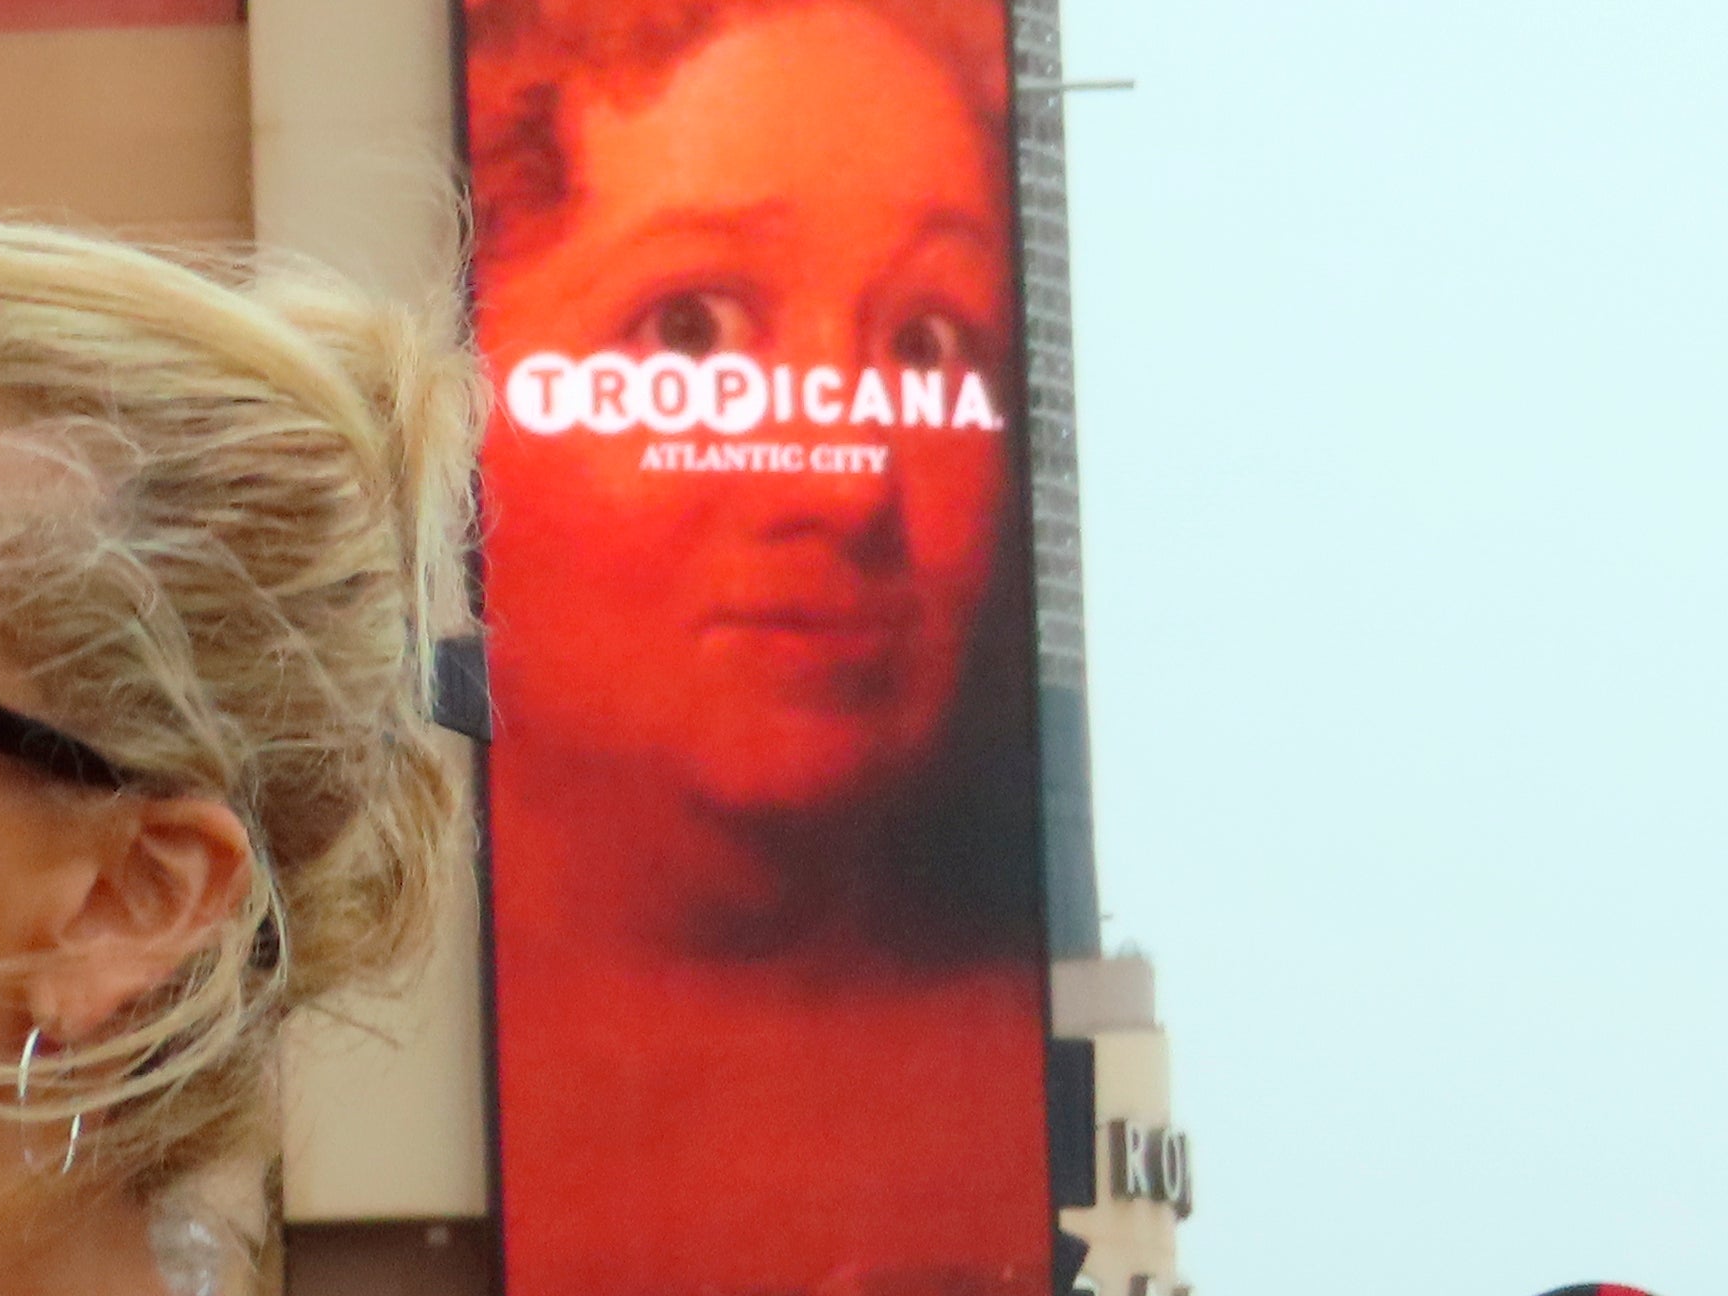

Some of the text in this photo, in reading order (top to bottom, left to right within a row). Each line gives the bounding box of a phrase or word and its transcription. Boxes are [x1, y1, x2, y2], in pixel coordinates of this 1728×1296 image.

[507, 351, 1002, 434] TROPICANA
[640, 442, 888, 473] ATLANTIC CITY
